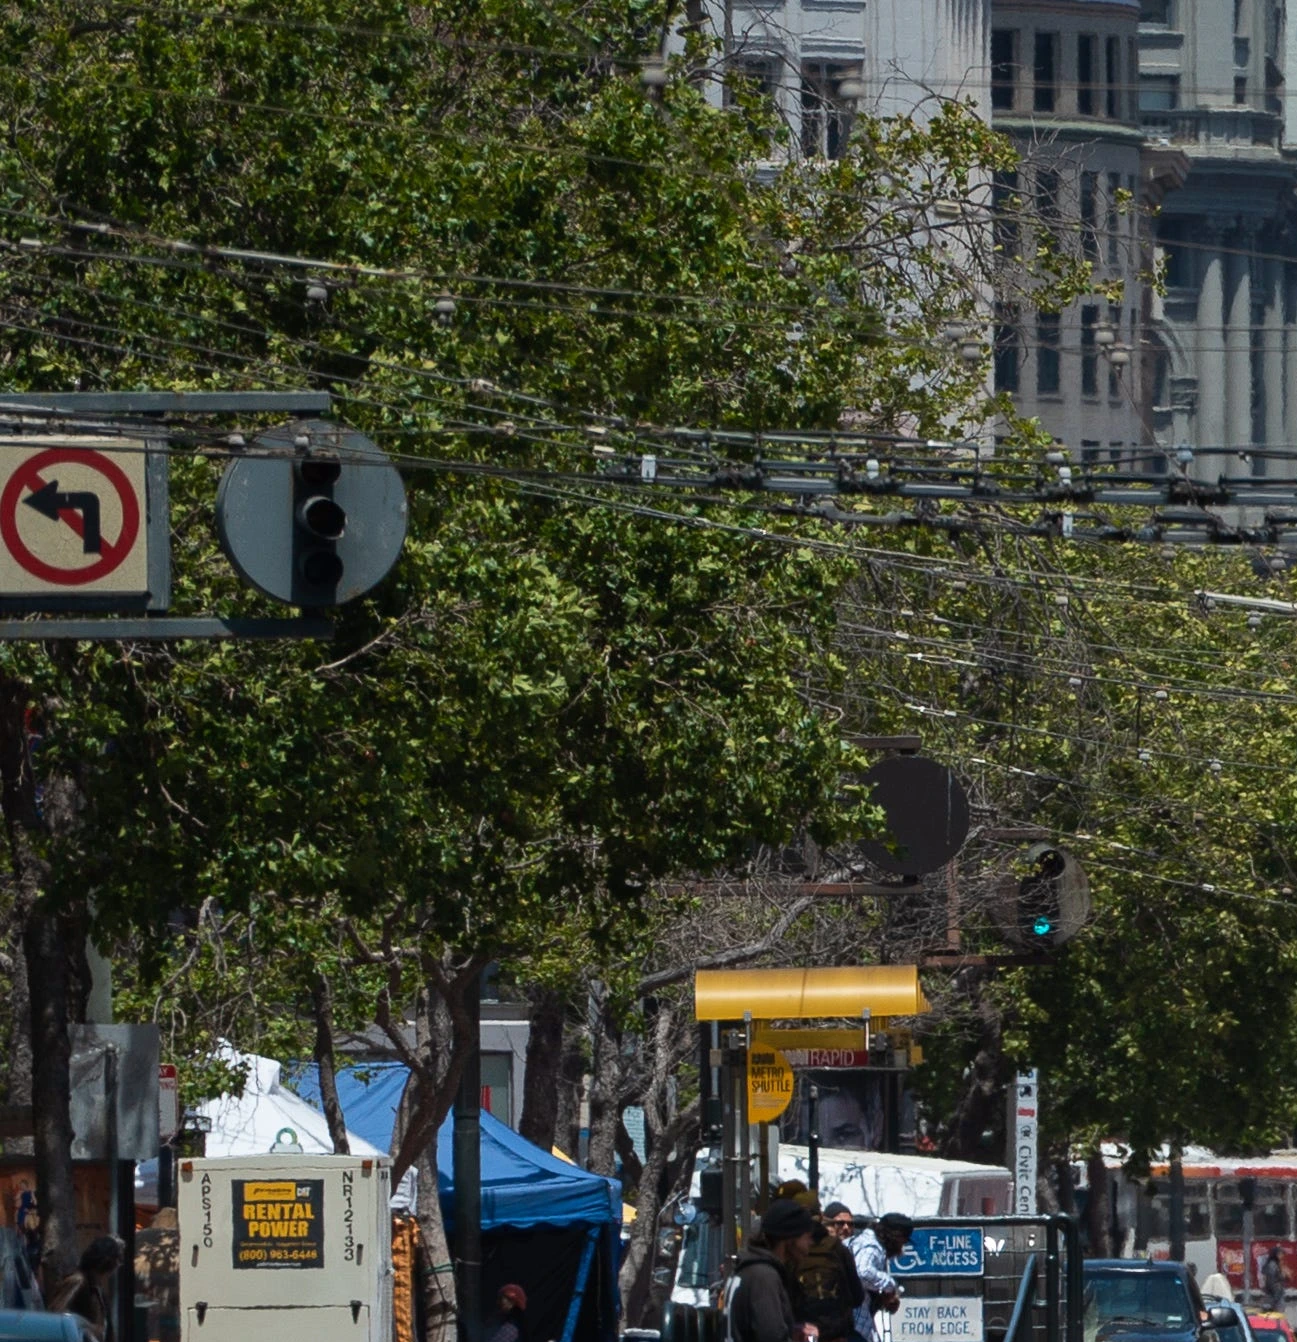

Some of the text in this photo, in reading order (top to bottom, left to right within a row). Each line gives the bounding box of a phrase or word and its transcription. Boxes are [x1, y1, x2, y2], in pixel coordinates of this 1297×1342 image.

[810, 1050, 854, 1066] RAPID
[751, 1066, 785, 1080] METRO
[751, 1079, 791, 1093] SHUTTLE
[1018, 1145, 1033, 1216] Civic Cen
[200, 1172, 214, 1249] APS150
[242, 1203, 316, 1221] RENTAL
[341, 1170, 355, 1262] NR12133
[247, 1221, 310, 1238] POWER
[928, 1235, 973, 1251] F-LINE
[239, 1249, 268, 1262] (800)
[931, 1251, 978, 1266] ACCESS
[904, 1305, 968, 1319] STAY BACK
[901, 1321, 935, 1335] FROM
